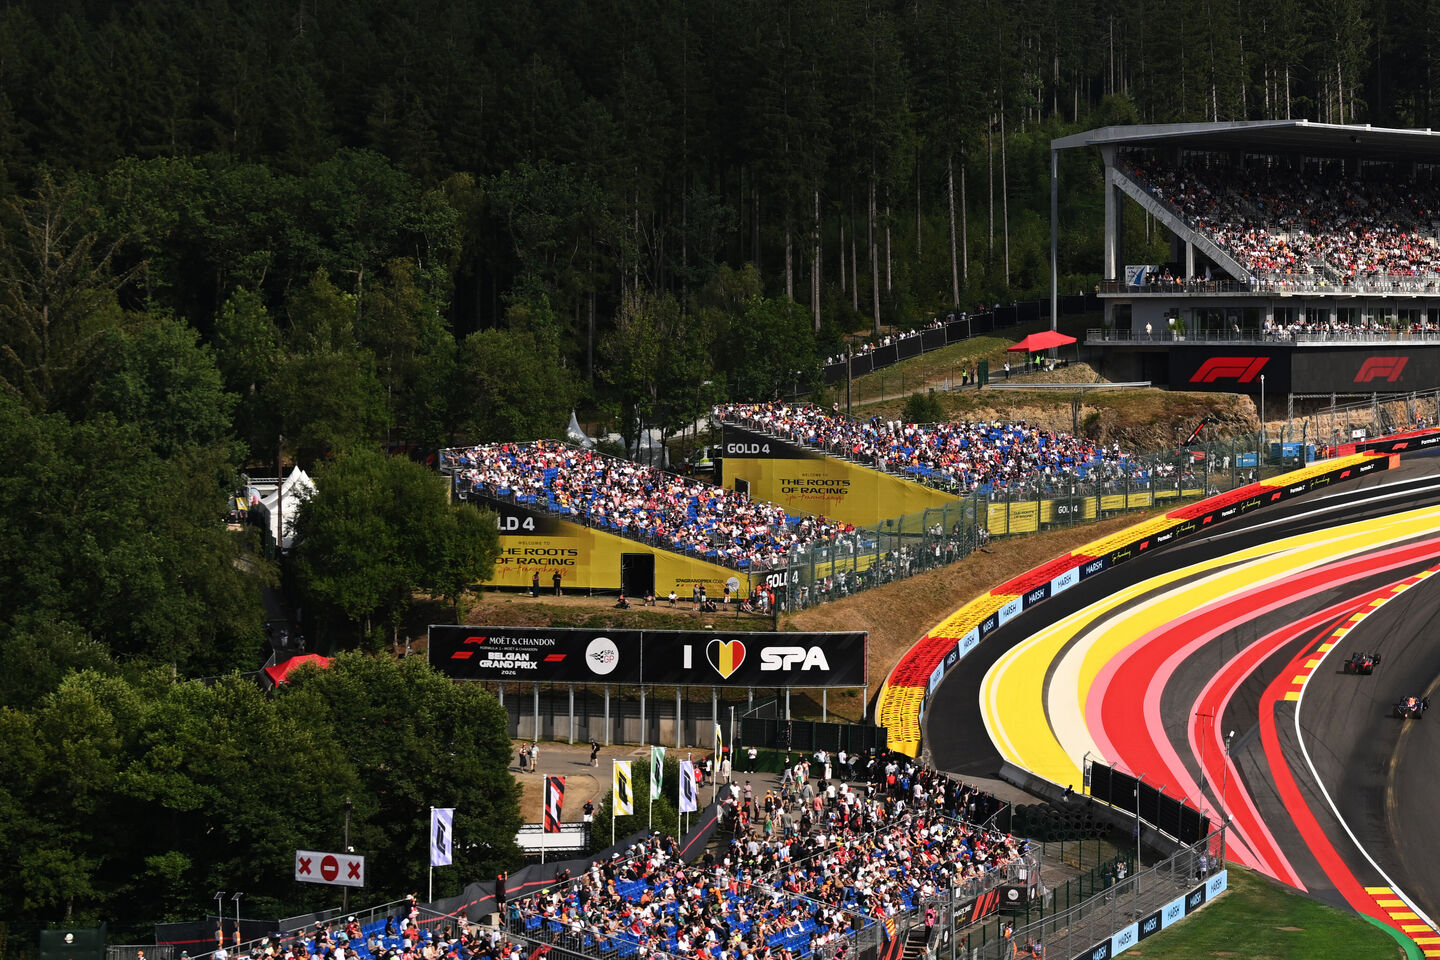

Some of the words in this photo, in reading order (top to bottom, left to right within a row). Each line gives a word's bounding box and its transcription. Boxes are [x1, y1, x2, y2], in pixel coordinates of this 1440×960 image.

[1189, 357, 1271, 382] F1
[1353, 357, 1409, 382] F1
[727, 443, 760, 454] GOLD
[762, 443, 770, 454] 4
[780, 478, 805, 486] THE
[782, 486, 798, 494] OF
[800, 487, 848, 495] RACING
[497, 516, 519, 530] LD
[522, 517, 535, 531] 4
[524, 548, 578, 556] ROOTS
[516, 558, 575, 566] RACING
[1086, 560, 1104, 575] MARSH
[792, 570, 799, 584] 4
[1058, 574, 1072, 590] MARSH
[1028, 588, 1045, 604] MARSH
[1003, 602, 1017, 619] MARSH
[489, 636, 511, 644] MOËT
[518, 638, 556, 646] CHANDON
[488, 652, 530, 660] BELGIAN
[604, 655, 614, 664] GP
[684, 644, 692, 669] I
[760, 646, 830, 671] SPA
[480, 660, 514, 668] GRAND
[514, 661, 538, 670] PRIX
[1210, 878, 1222, 893] MARSH
[1189, 891, 1202, 908] MARSH
[1168, 904, 1180, 921] MARSH
[1144, 916, 1157, 934] MARSH
[1118, 930, 1132, 948] MARSH
